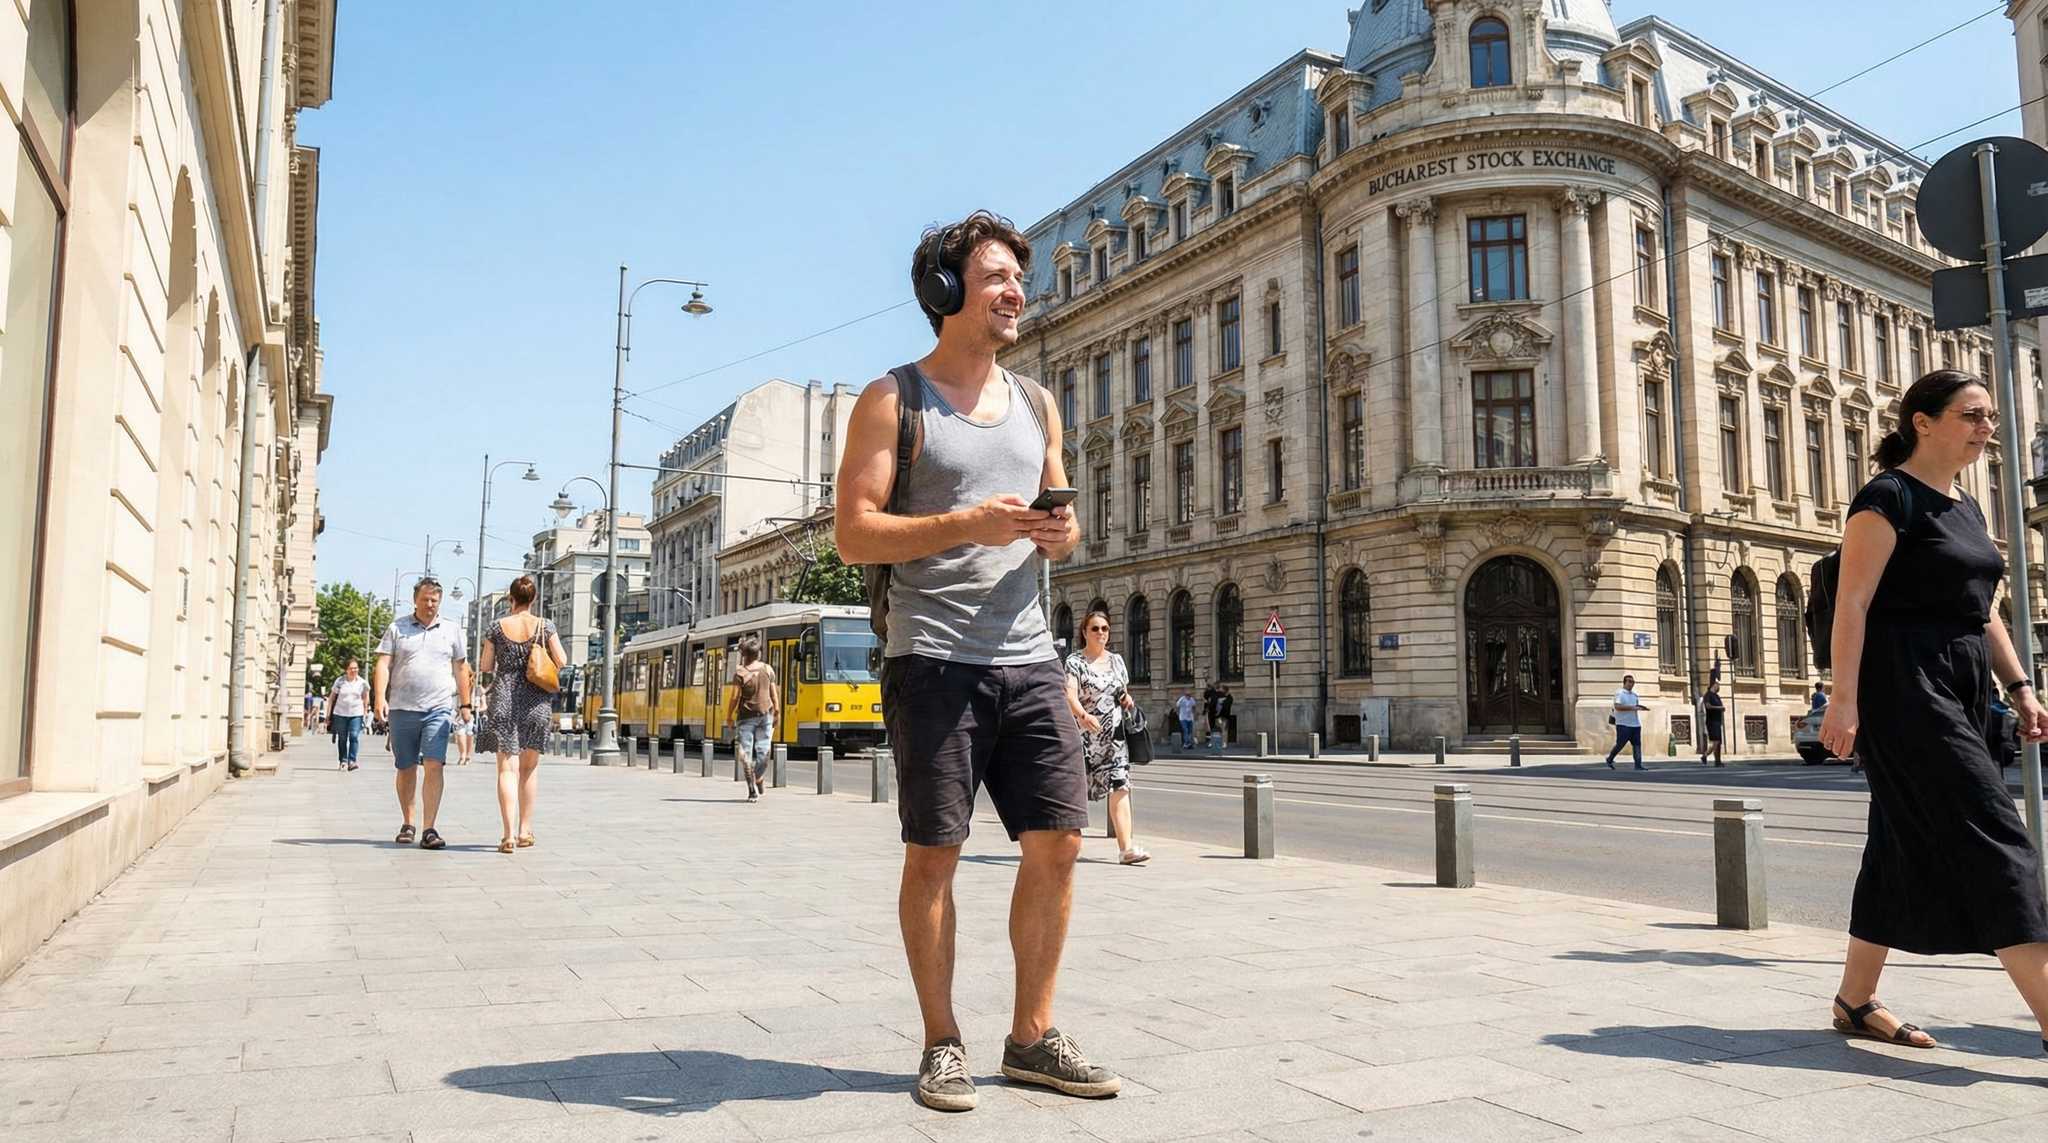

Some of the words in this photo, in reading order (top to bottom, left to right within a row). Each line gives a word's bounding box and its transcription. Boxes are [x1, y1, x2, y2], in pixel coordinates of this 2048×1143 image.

[1369, 157, 1457, 196] BUCHAREST
[1467, 150, 1524, 170] STOCK
[1533, 150, 1616, 175] EXCHANGE
